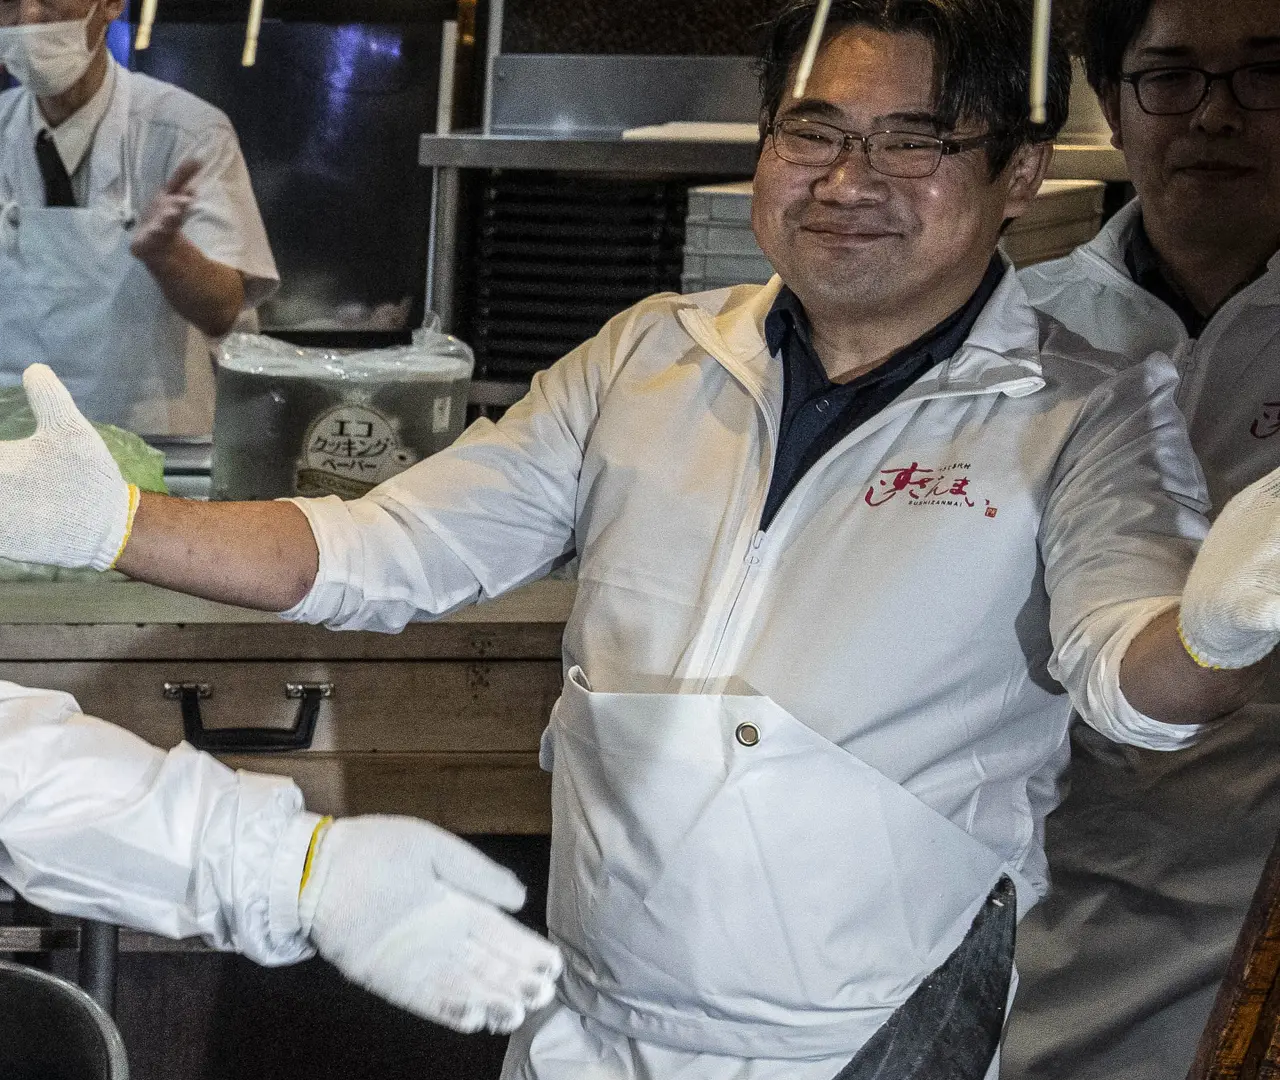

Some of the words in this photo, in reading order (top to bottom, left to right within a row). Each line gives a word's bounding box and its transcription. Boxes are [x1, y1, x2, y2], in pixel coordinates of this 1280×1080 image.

[331, 419, 373, 437] エコ
[312, 435, 393, 457] クッキング
